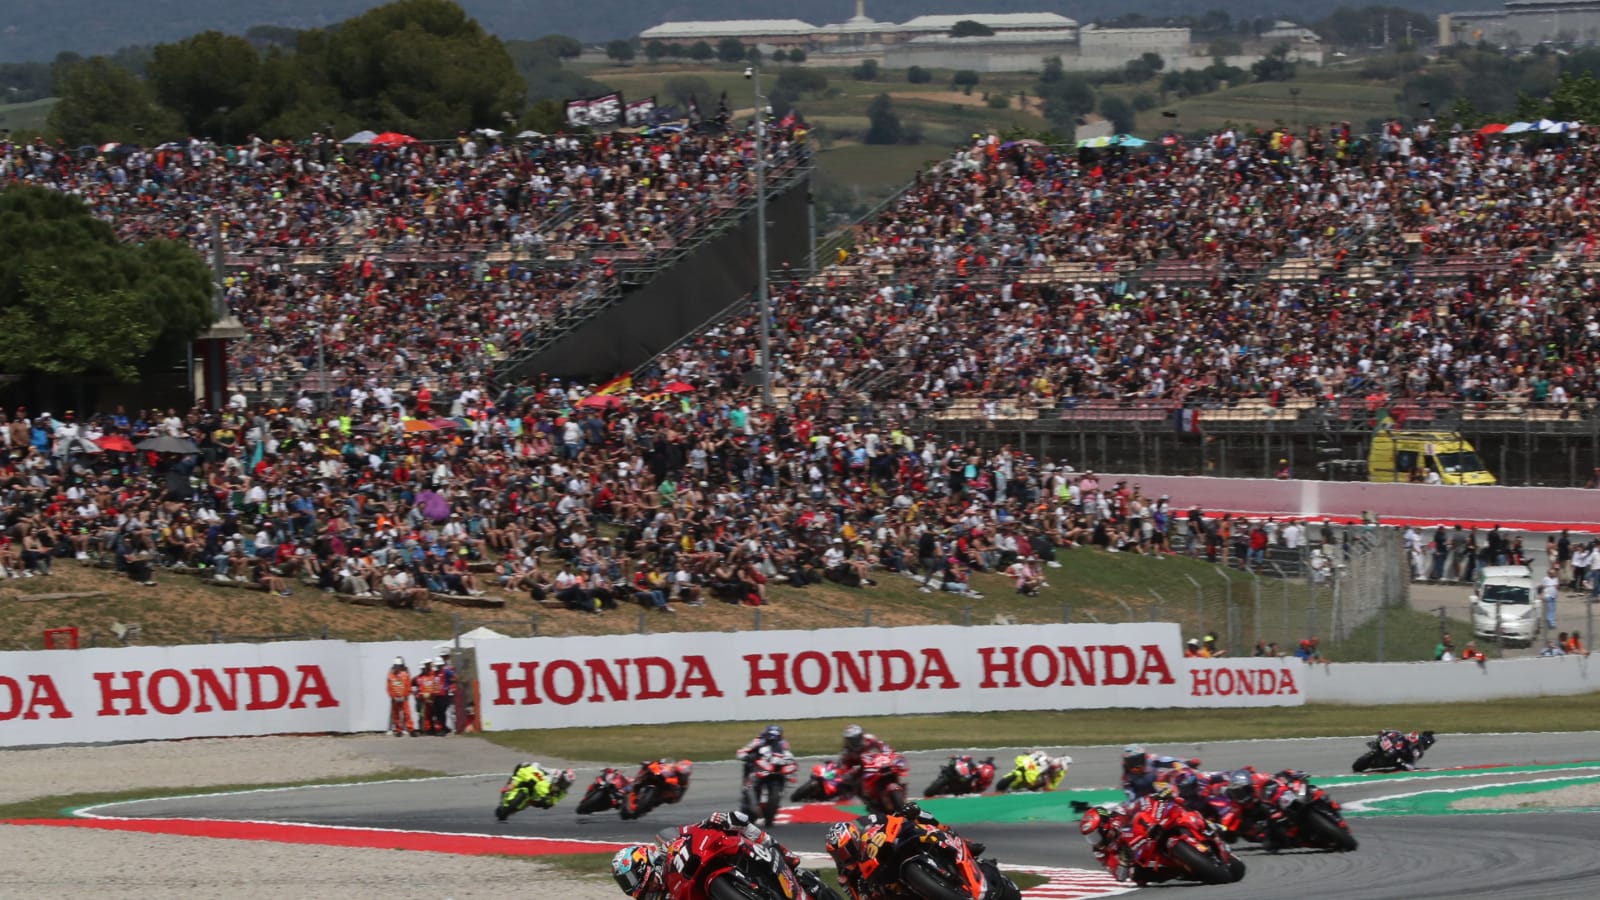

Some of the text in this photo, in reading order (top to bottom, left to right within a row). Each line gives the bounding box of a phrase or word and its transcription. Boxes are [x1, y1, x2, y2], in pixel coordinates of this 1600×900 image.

[93, 664, 340, 717] HONDA
[490, 644, 1175, 705] HONDA HONDA HONDA
[1189, 667, 1298, 697] HONDA
